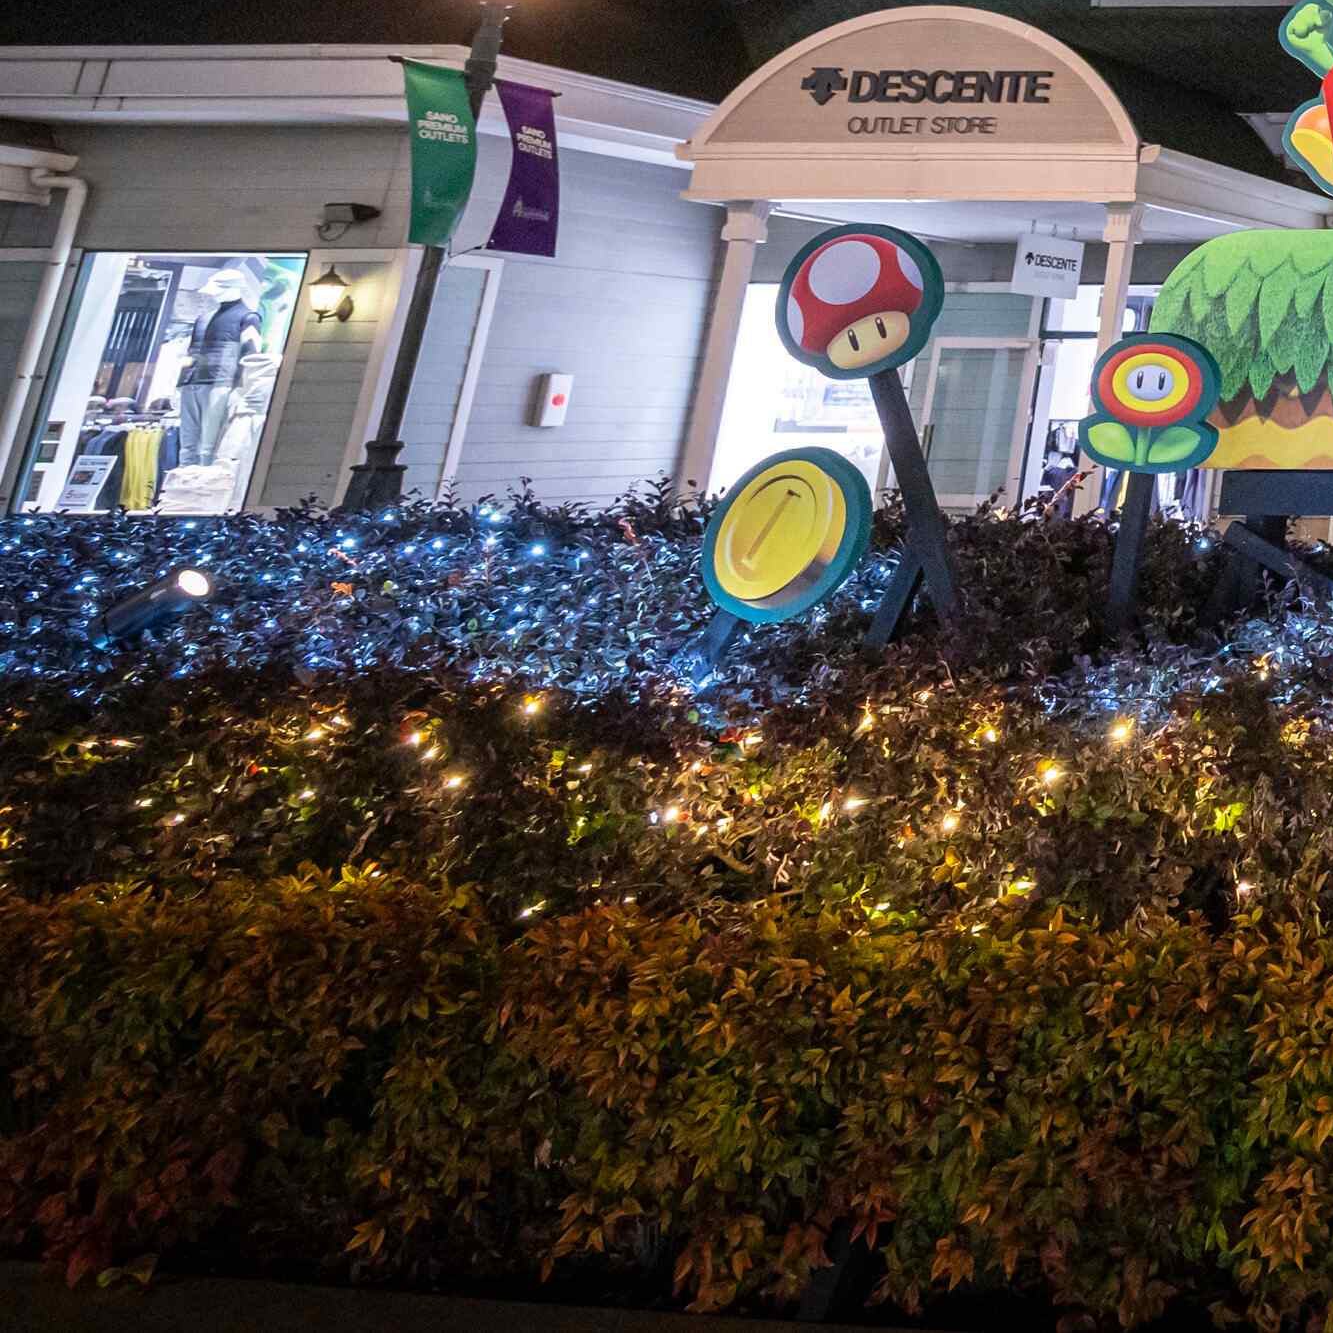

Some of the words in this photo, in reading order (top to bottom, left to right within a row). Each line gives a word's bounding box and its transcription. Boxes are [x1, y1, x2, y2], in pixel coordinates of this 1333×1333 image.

[848, 69, 1054, 104] DESCENTE
[848, 116, 927, 135] OUTLET
[931, 116, 998, 135] STORE
[418, 129, 470, 144] OUTLETS
[1035, 254, 1078, 272] DESCENTE
